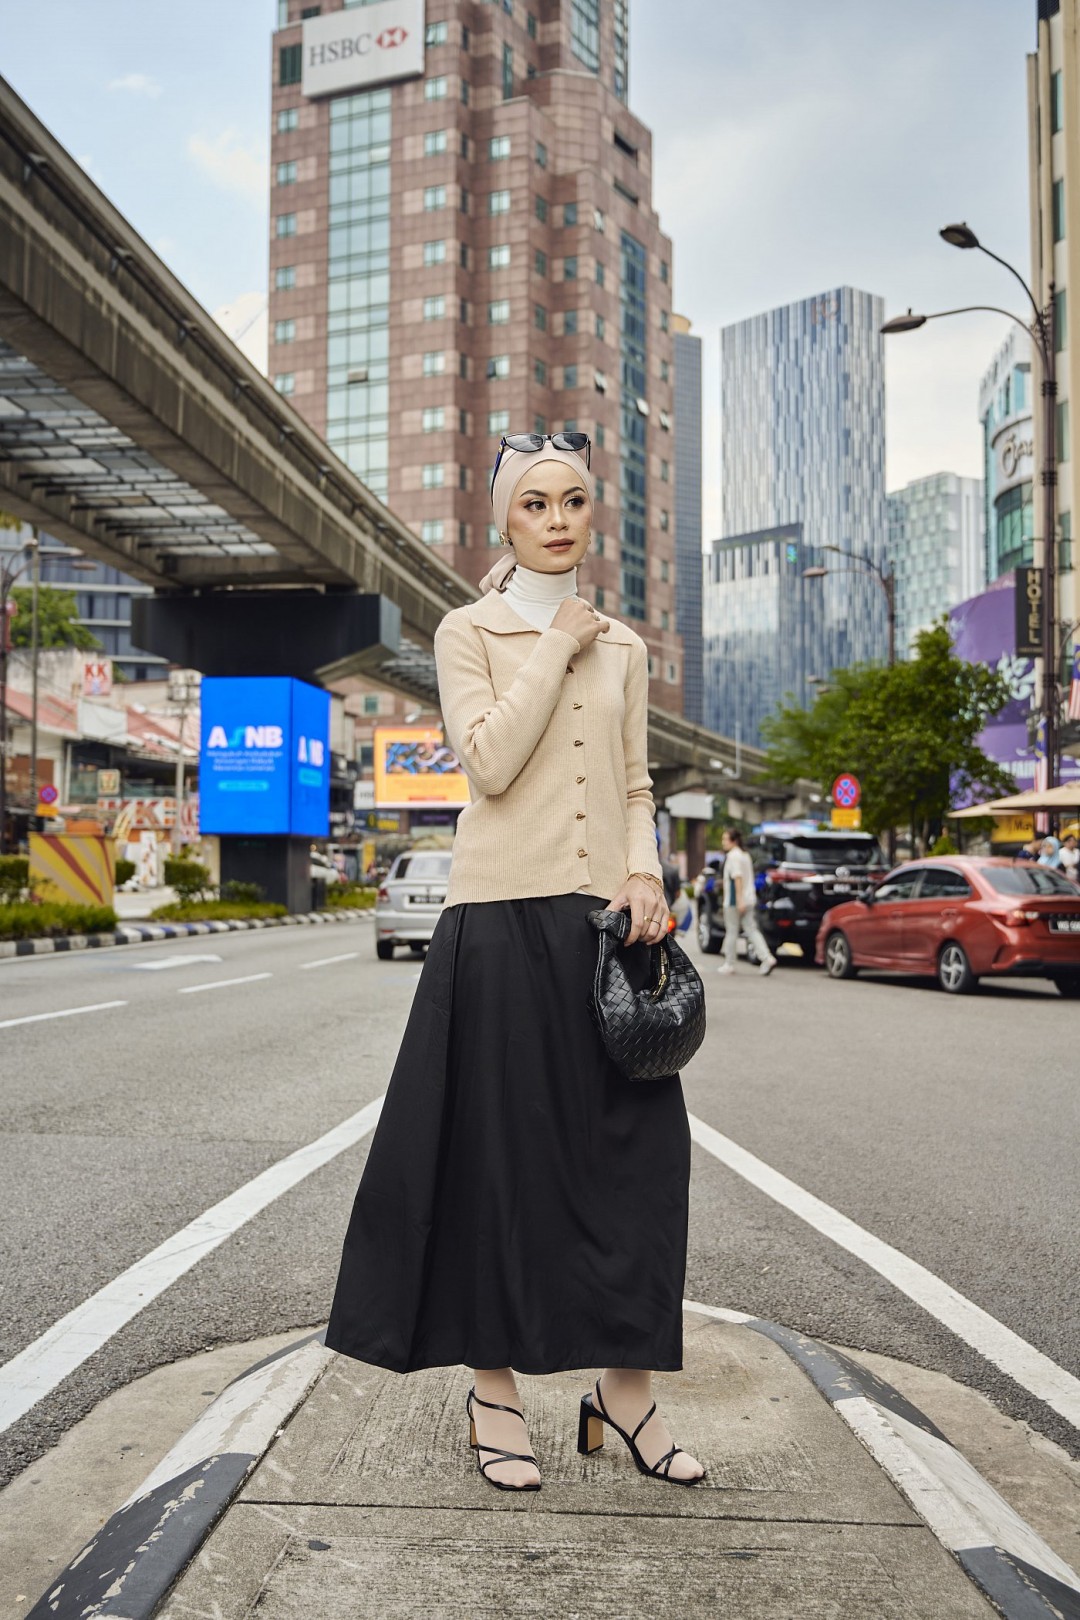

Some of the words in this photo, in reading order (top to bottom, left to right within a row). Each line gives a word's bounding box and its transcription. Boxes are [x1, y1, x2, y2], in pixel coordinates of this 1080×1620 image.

[308, 33, 371, 66] HSBC
[1027, 569, 1042, 644] HOTEL
[84, 663, 108, 680] KK
